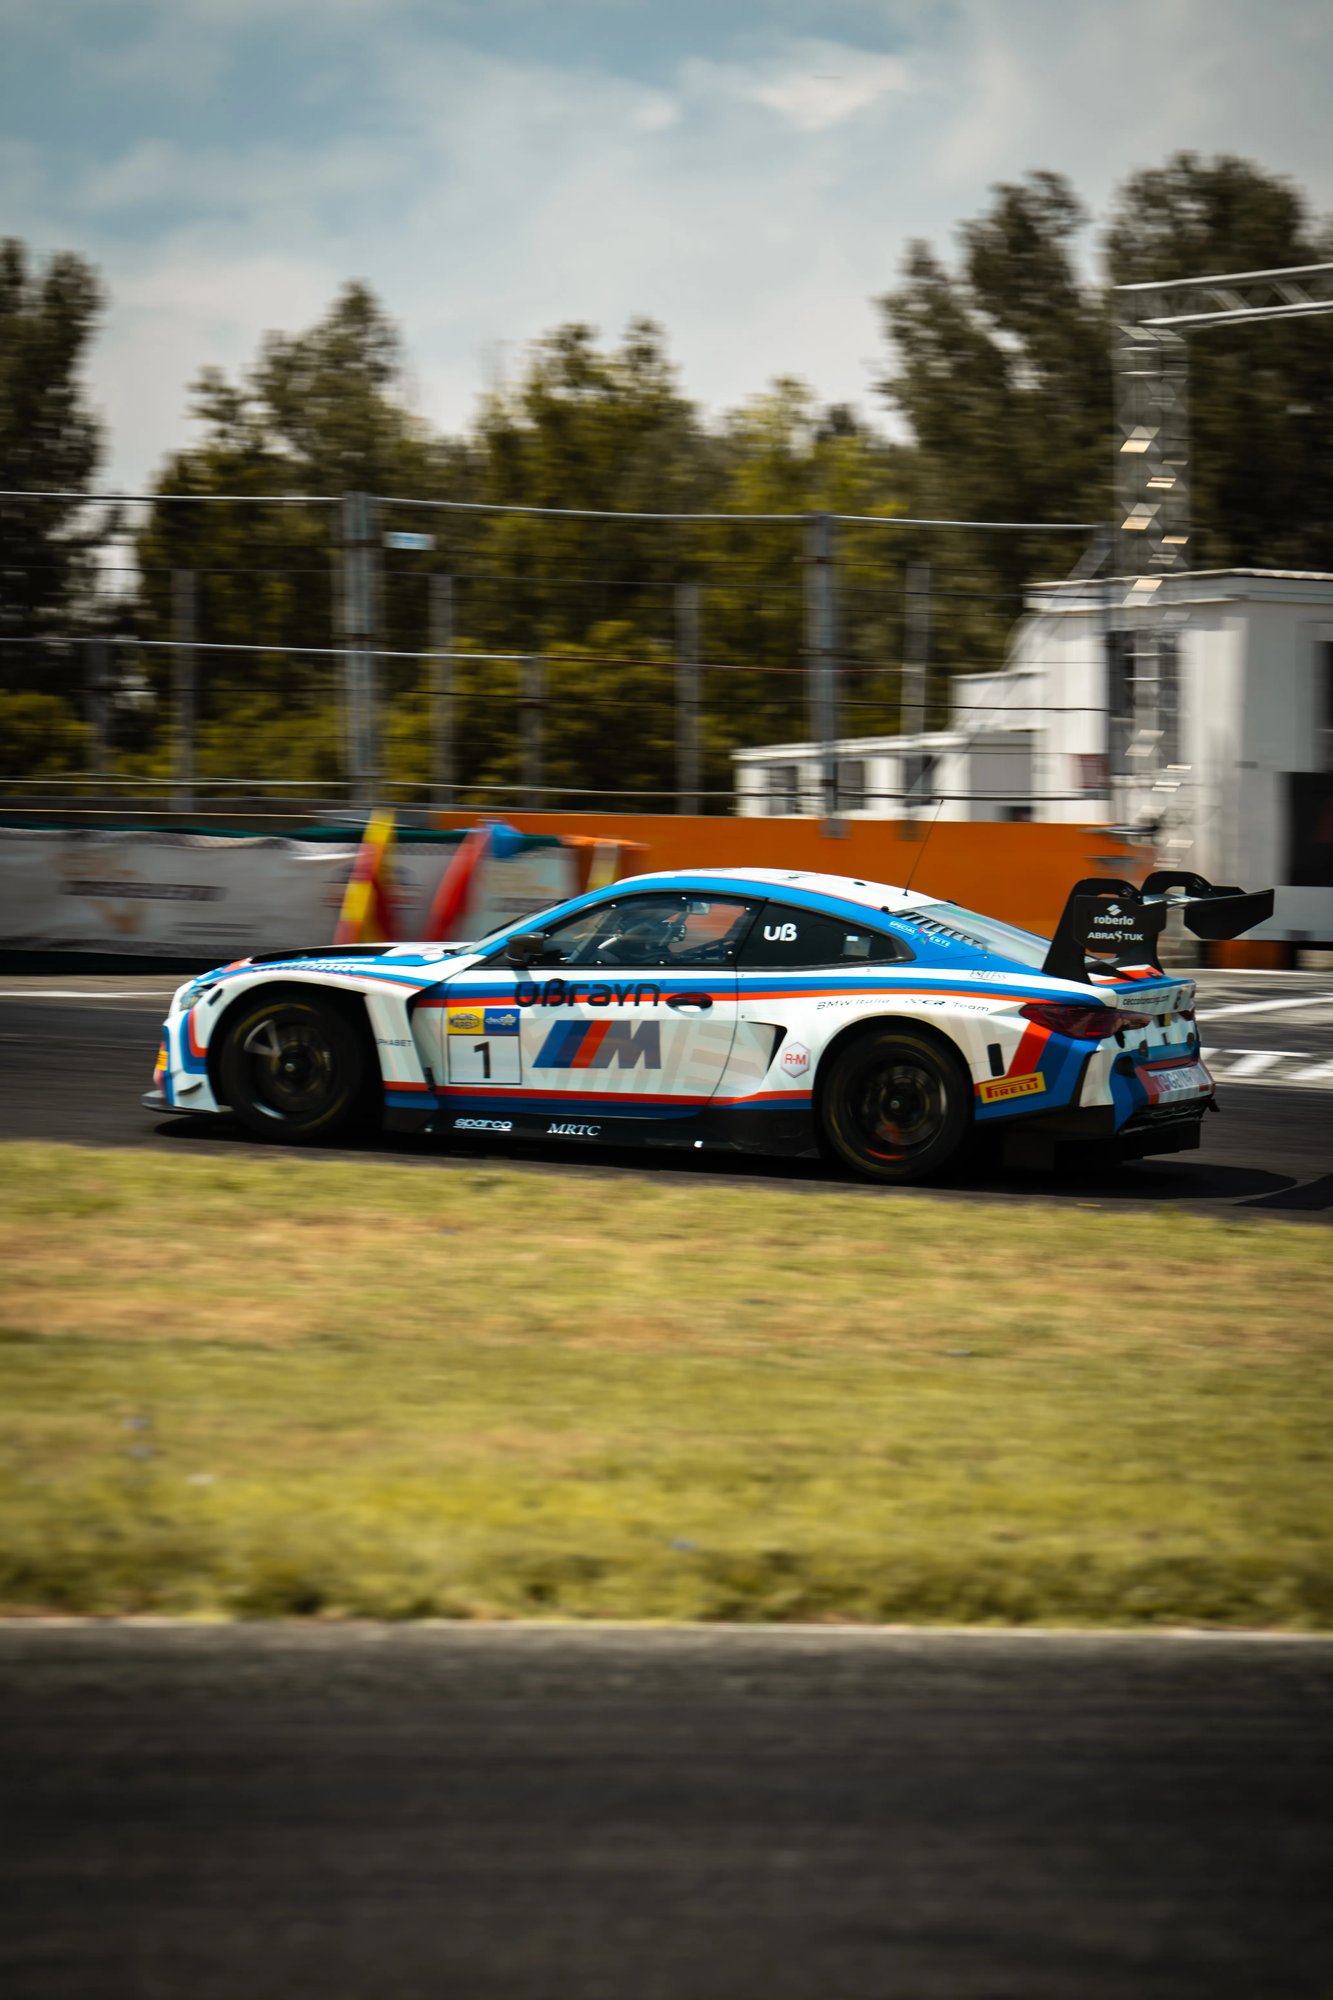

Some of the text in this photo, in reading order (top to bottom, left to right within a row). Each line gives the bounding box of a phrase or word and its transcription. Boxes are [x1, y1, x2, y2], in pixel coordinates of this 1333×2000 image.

[1093, 915, 1134, 926] roberlo
[816, 1000, 851, 1010] BMW
[953, 1002, 989, 1012] Team
[473, 1041, 491, 1079] 1
[985, 1077, 1039, 1098] PIRELLI
[454, 1118, 513, 1131] sparco
[547, 1123, 601, 1136] MRTC
